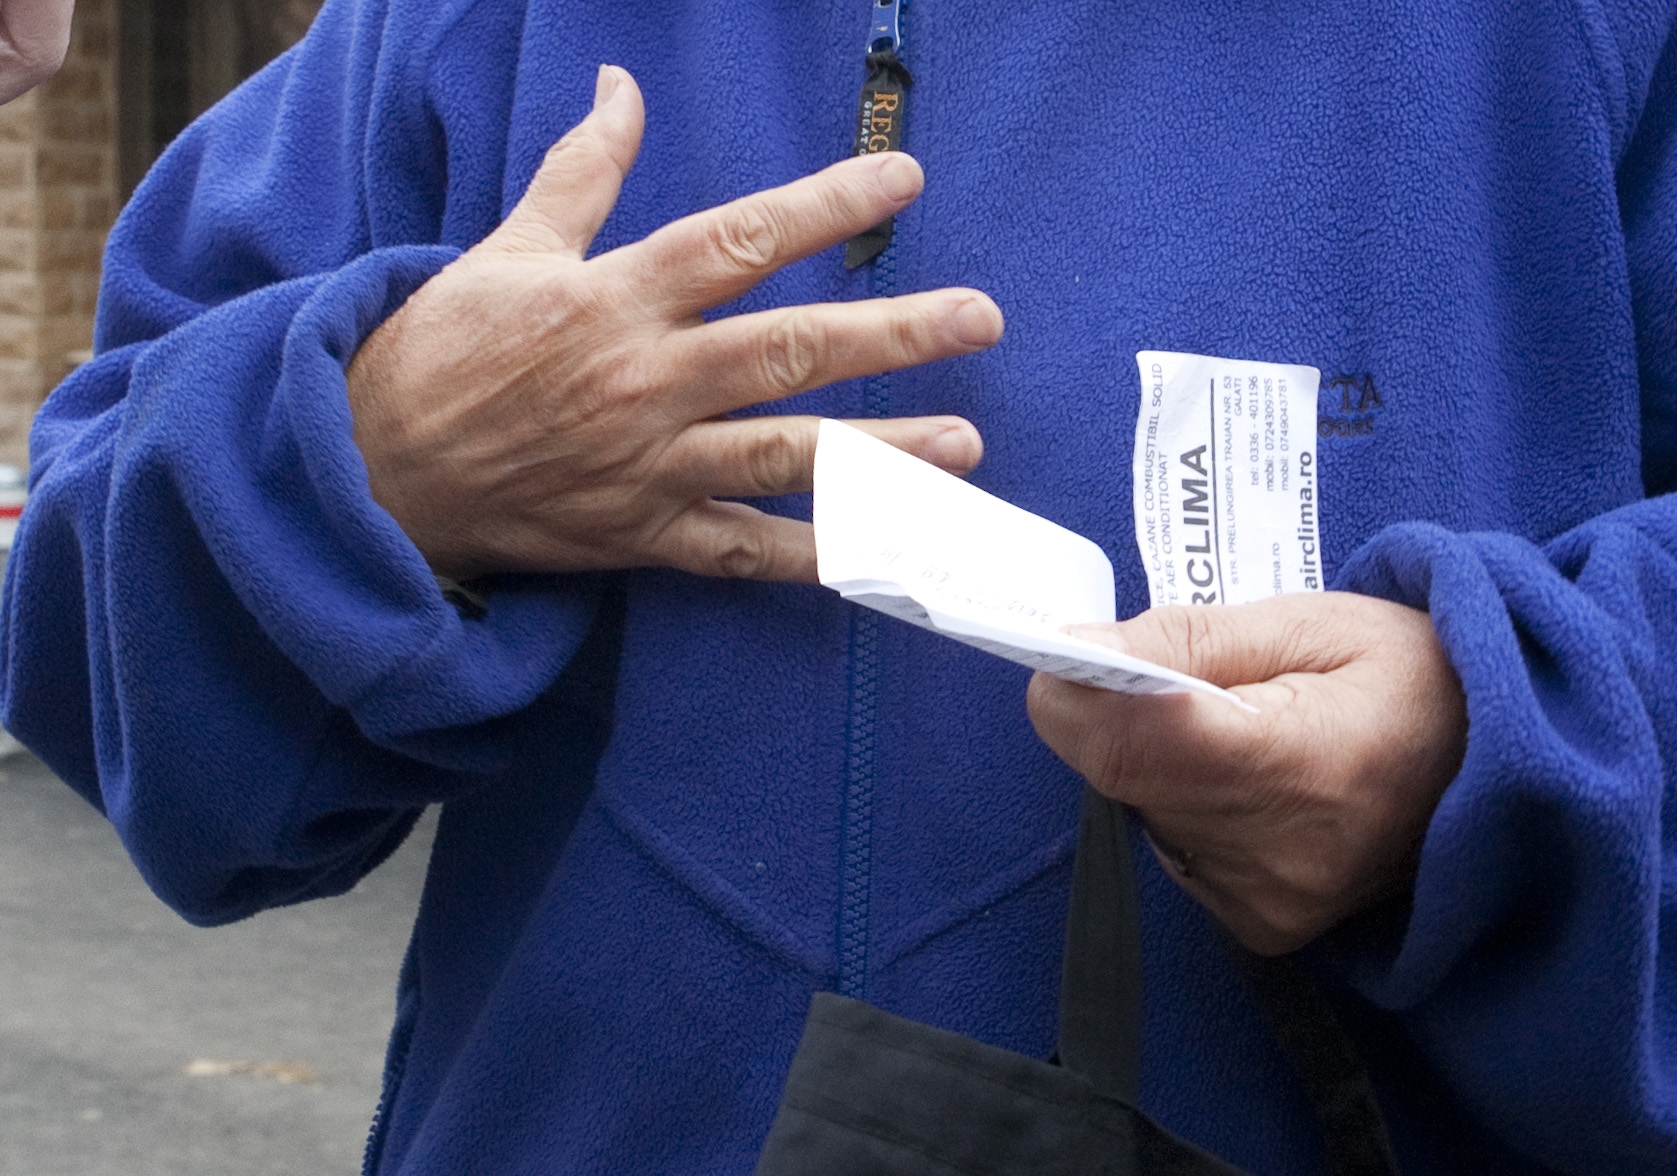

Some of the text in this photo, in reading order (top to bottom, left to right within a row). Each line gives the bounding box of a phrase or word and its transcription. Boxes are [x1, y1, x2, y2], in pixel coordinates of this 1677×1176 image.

[860, 101, 872, 144] GREAT
[1151, 363, 1163, 407] SOLID
[1223, 376, 1232, 389] 53
[1234, 378, 1242, 416] GALATI
[1249, 376, 1258, 420] 401196
[1224, 417, 1233, 461] TRAIAN
[1250, 433, 1259, 463] 0336
[1263, 378, 1275, 491] mobil: 0724309785
[1144, 412, 1160, 511] COMBUSTIBIL
[1250, 467, 1259, 486] tel:
[1158, 451, 1172, 554] CONDITIONAT
[1180, 444, 1216, 604] RCLIMA
[1224, 465, 1236, 554] PRELUNGIREA
[1297, 451, 1318, 589] airclima.ro
[1145, 516, 1161, 571] CAZANE
[1165, 560, 1176, 588] AER
